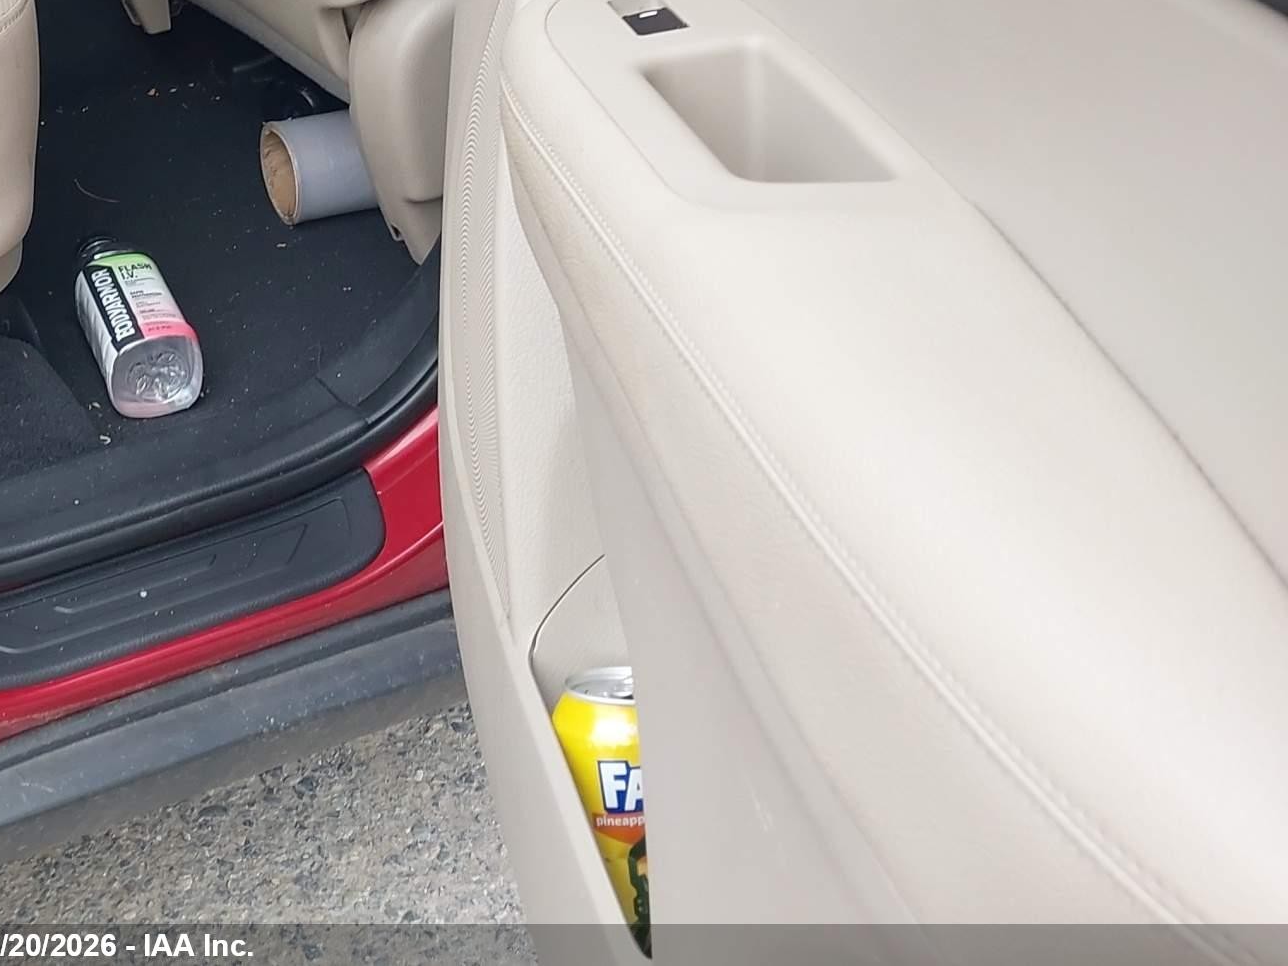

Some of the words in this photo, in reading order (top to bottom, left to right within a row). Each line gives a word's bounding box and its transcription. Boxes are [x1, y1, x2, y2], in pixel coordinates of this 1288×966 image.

[117, 263, 152, 273] FLASH
[121, 270, 138, 280] I.V.
[91, 269, 135, 342] BODYARMOR
